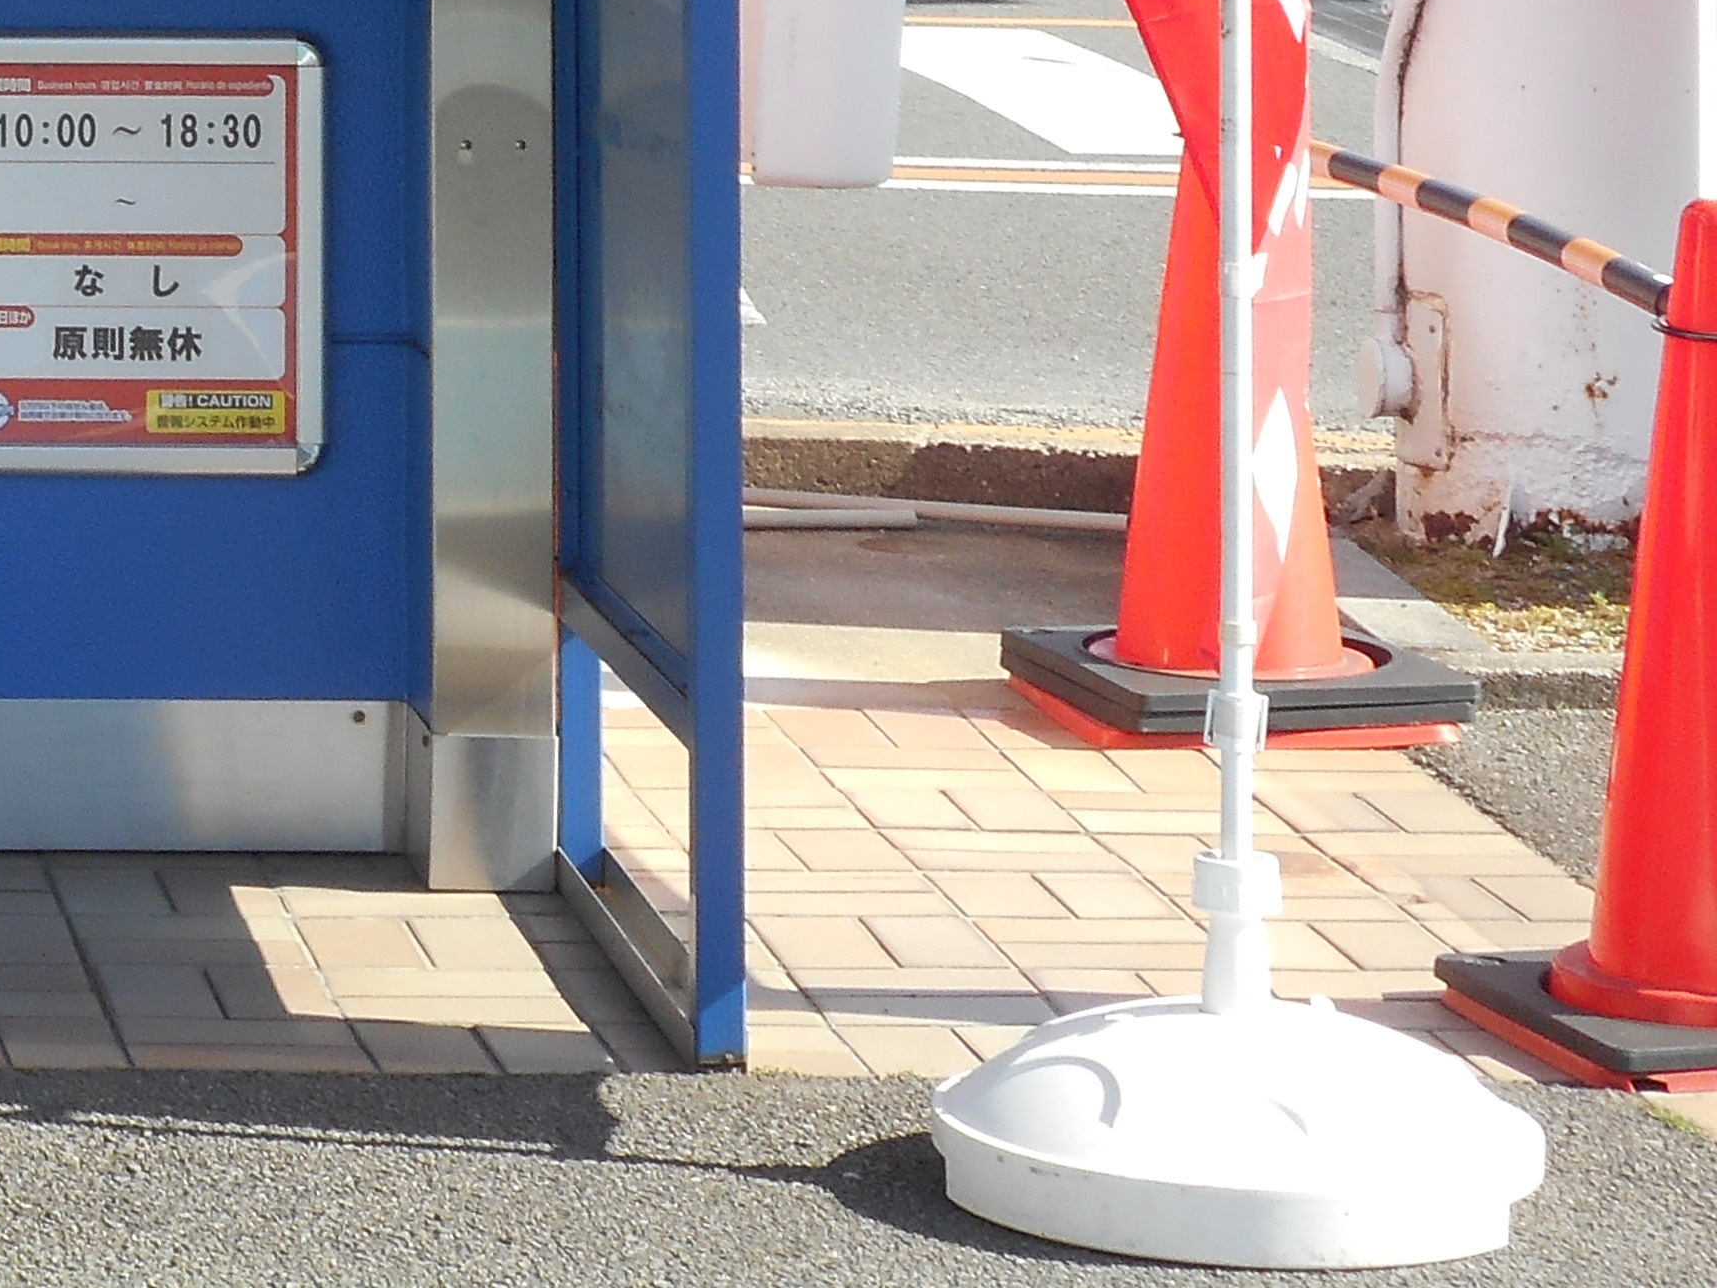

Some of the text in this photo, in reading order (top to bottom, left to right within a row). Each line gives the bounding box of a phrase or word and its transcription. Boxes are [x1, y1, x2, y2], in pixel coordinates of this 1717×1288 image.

[161, 112, 262, 150] 18:30
[52, 326, 203, 362] 原則無休
[197, 394, 272, 408] CAUTION
